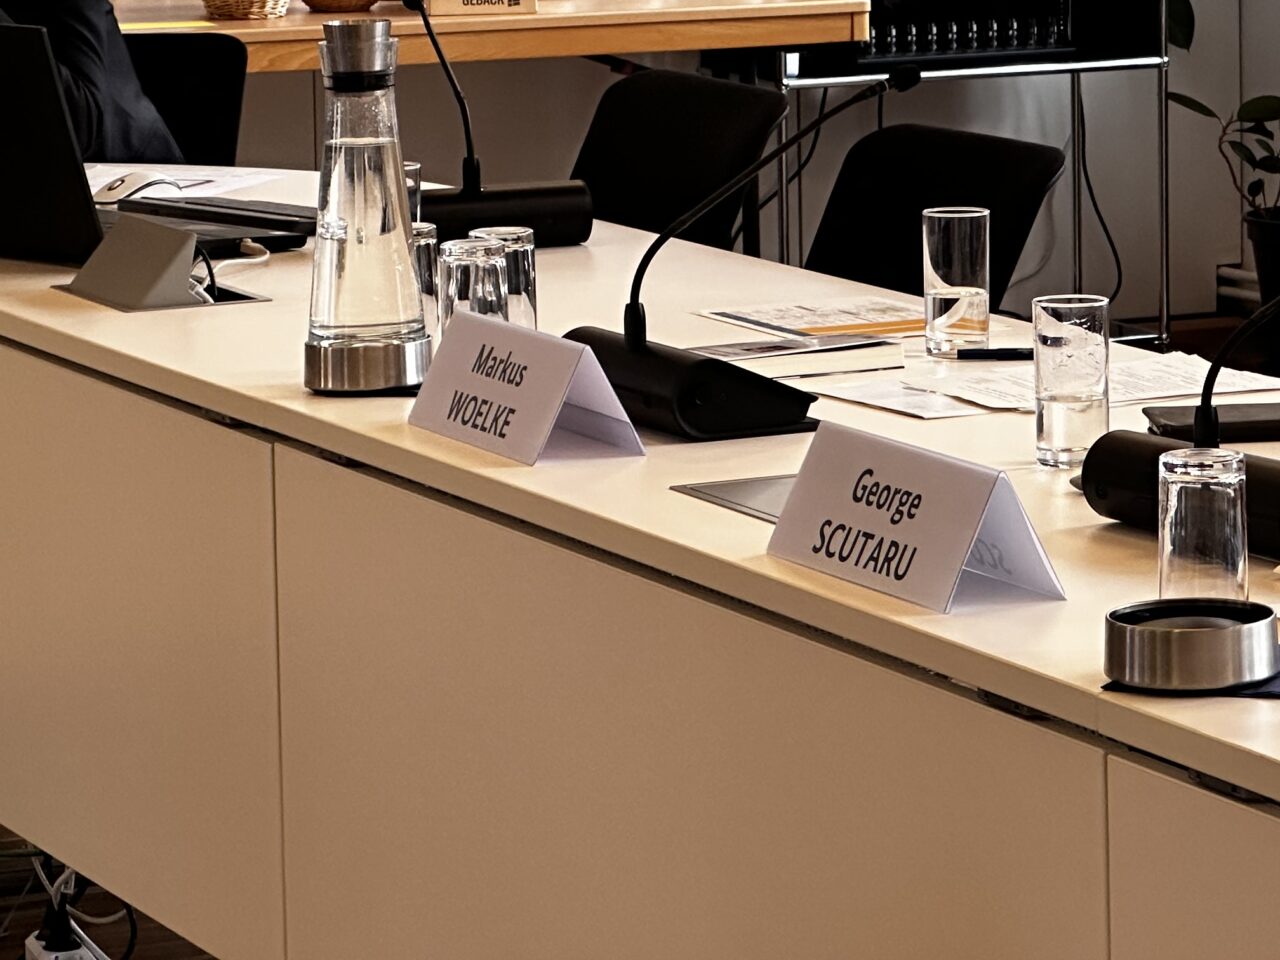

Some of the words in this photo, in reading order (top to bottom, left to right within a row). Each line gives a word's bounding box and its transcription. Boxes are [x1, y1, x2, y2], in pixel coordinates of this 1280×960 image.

[471, 343, 528, 388] Markus
[446, 389, 517, 440] WOELKE
[851, 467, 923, 526] George
[811, 518, 918, 581] SCUTARU
